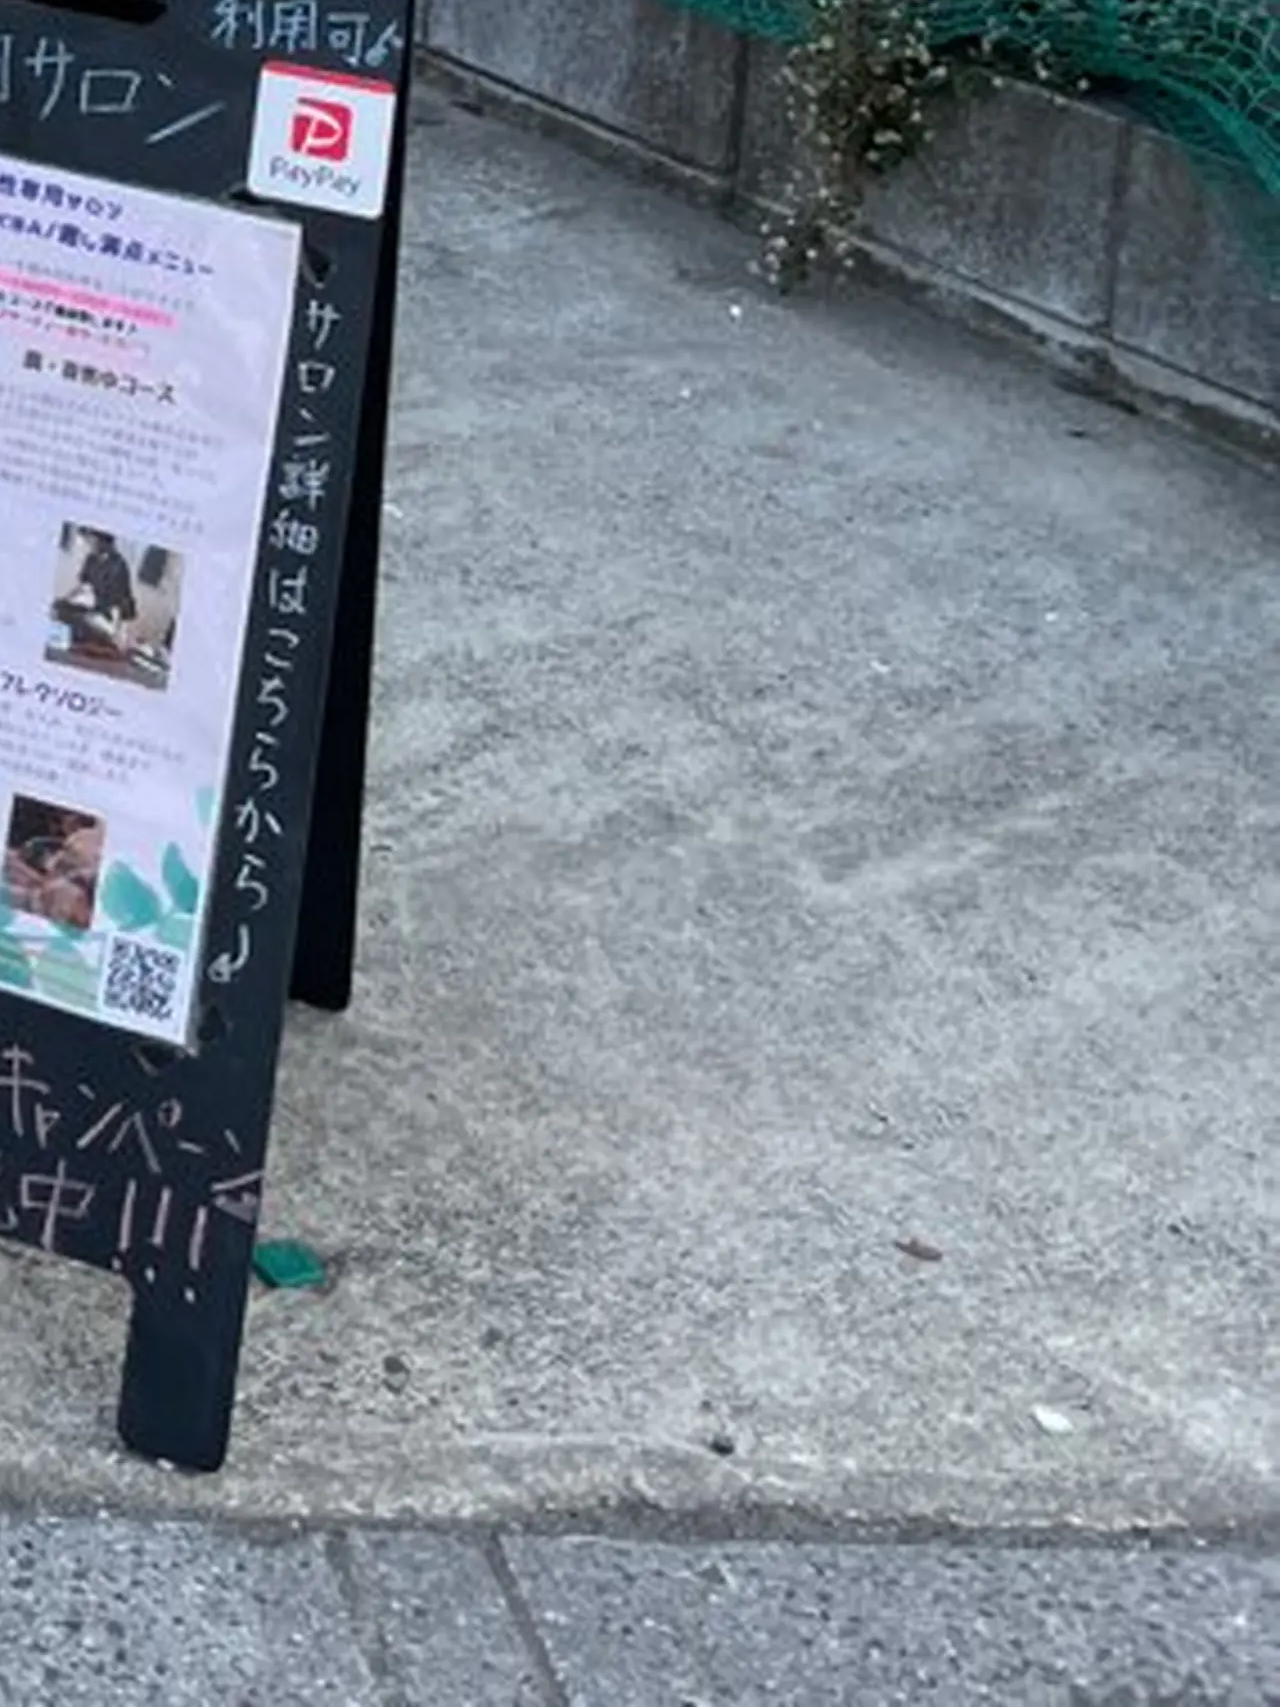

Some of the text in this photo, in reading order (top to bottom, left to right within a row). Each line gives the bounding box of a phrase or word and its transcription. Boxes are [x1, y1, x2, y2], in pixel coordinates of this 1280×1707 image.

[269, 155, 360, 196] PayPay
[235, 297, 342, 909] サロン詳細はこちらから
